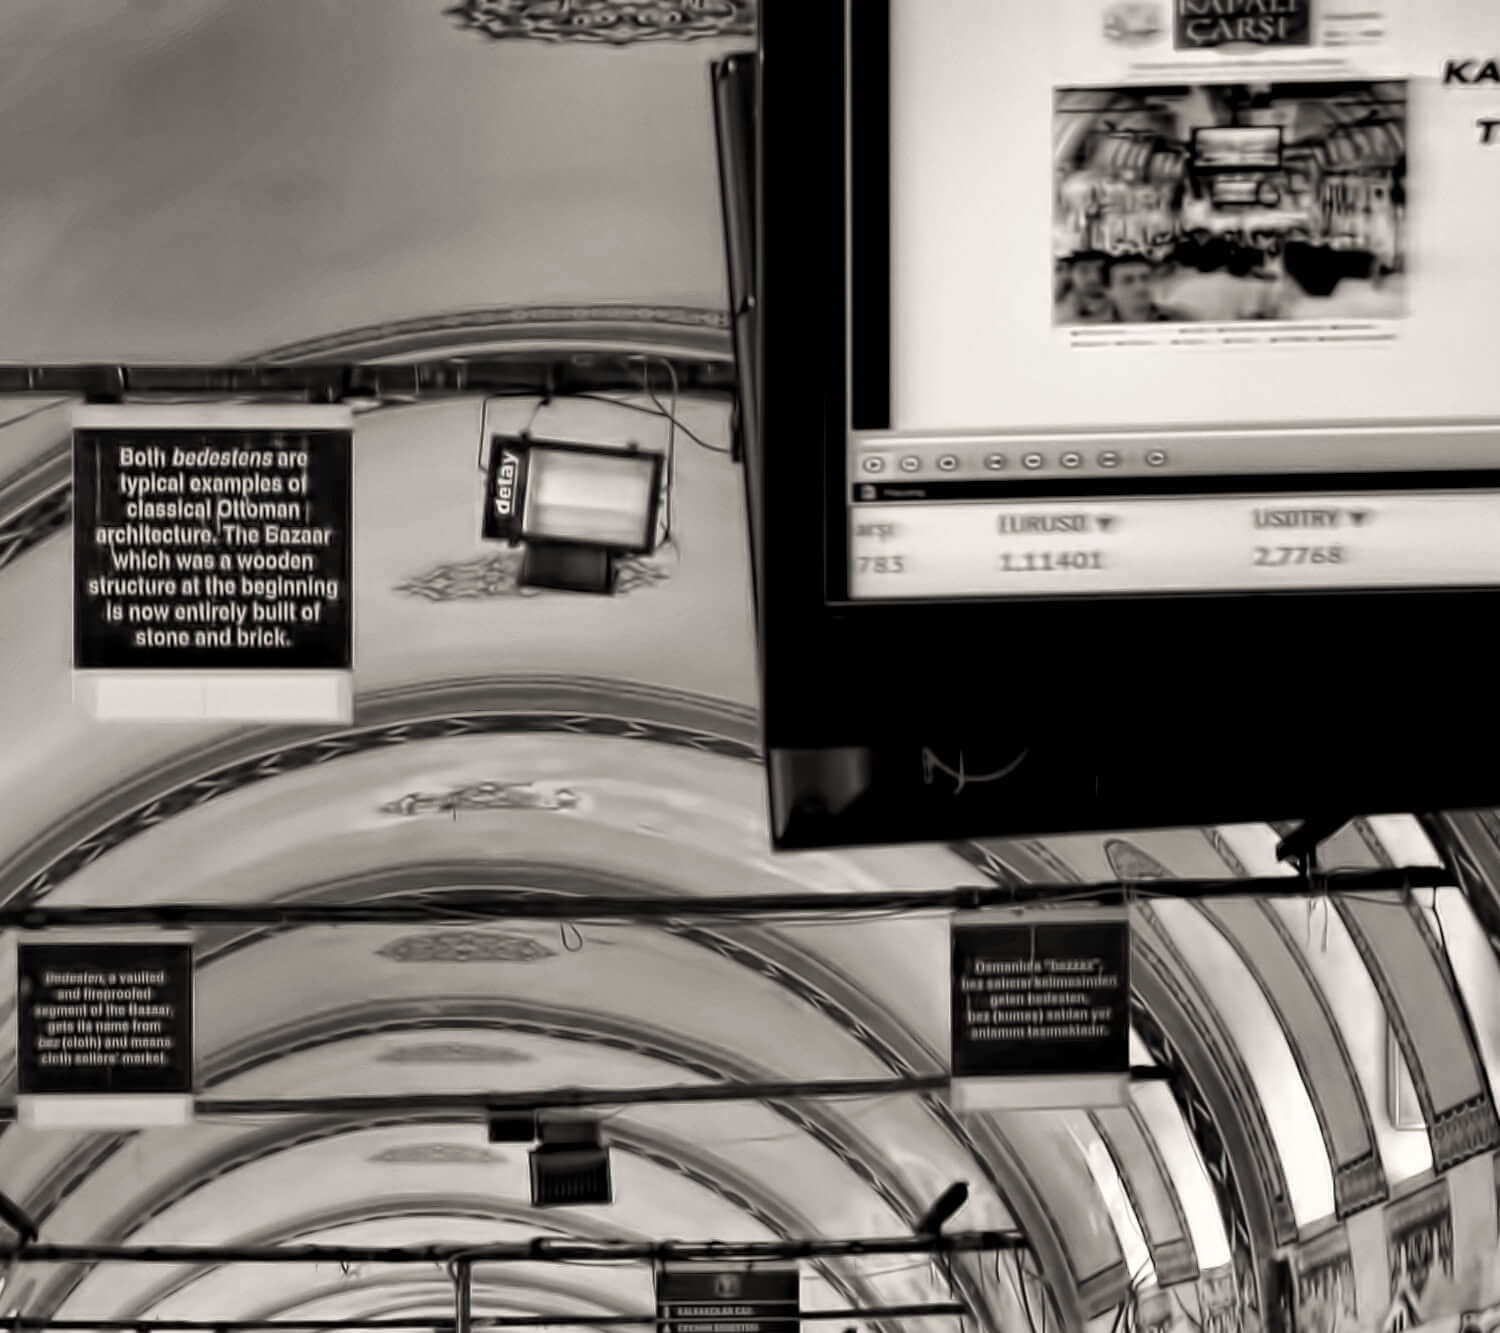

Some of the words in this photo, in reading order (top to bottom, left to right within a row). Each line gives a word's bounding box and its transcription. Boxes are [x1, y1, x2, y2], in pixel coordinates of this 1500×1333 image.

[119, 446, 166, 468] Both
[172, 446, 275, 468] bedestens
[278, 450, 308, 468] are
[120, 472, 184, 498] typical
[190, 472, 282, 498] examples
[288, 472, 308, 495] of
[127, 499, 211, 520] classical
[216, 499, 300, 520] Ottoman
[96, 524, 218, 545] architecture.
[222, 524, 259, 545] The
[265, 524, 333, 545] Bazaar
[112, 550, 171, 571] which
[176, 554, 215, 571] was
[220, 555, 232, 571] a
[237, 550, 313, 571] wooden
[88, 575, 176, 596] structure
[181, 576, 200, 596] at
[205, 575, 236, 596] the
[241, 575, 339, 601] beginning
[106, 600, 123, 621] is
[128, 604, 169, 621] now
[174, 600, 248, 626] entirely
[252, 600, 296, 621] built
[301, 600, 321, 621] of
[135, 628, 190, 648] stone
[195, 627, 232, 648] and
[236, 627, 293, 648] brick.
